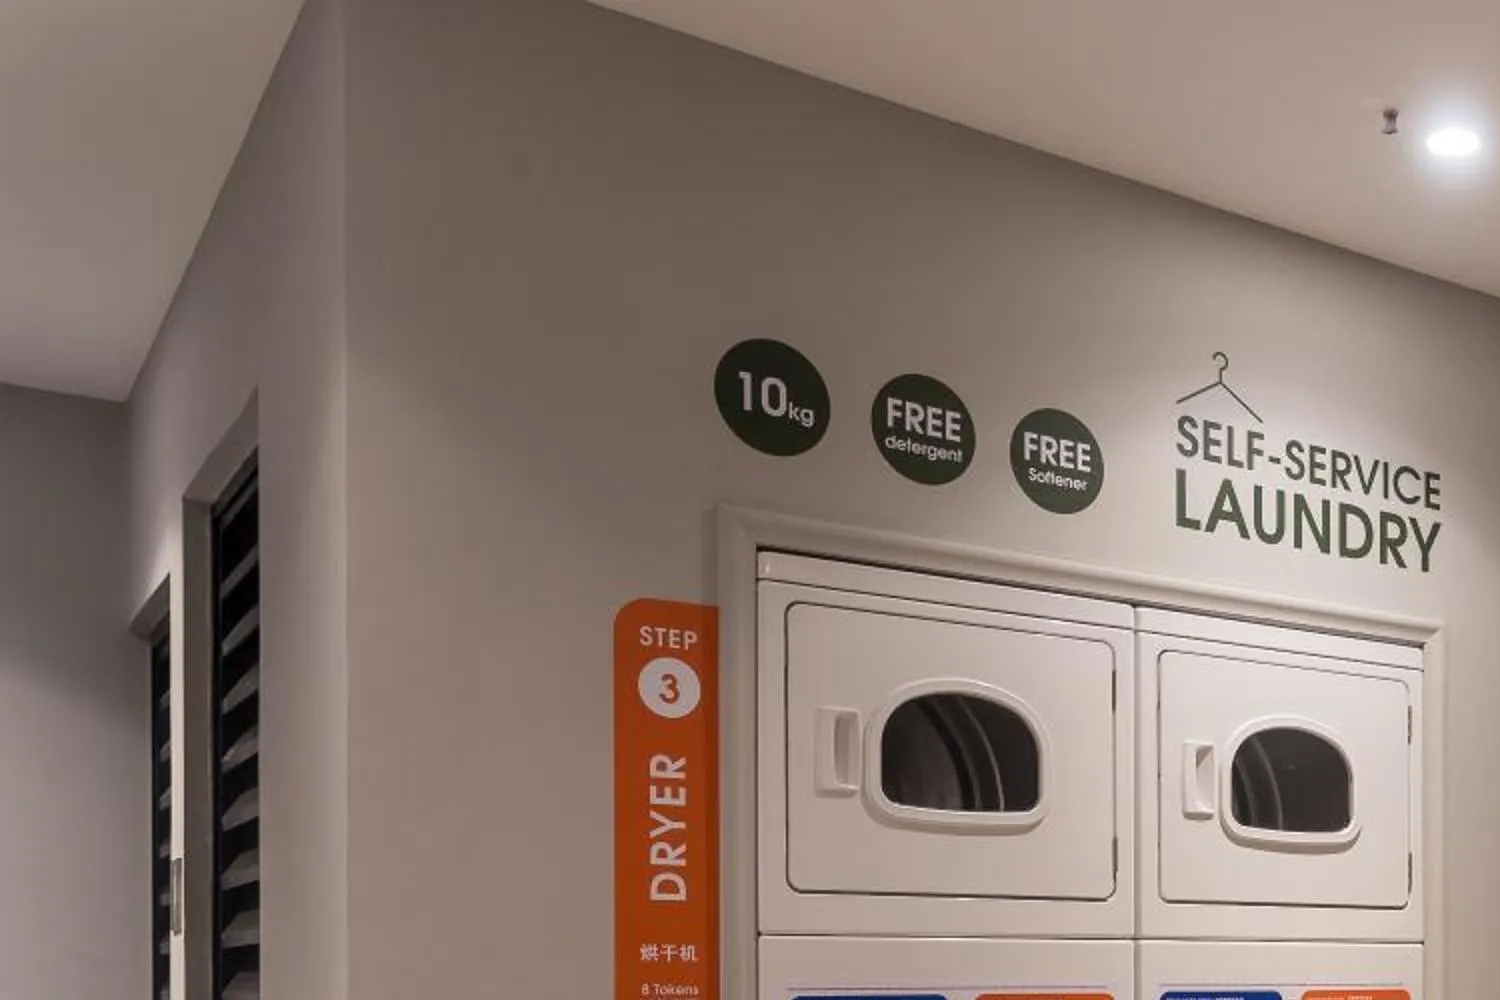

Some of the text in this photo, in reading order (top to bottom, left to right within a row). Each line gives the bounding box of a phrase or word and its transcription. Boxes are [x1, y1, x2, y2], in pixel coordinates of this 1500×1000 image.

[886, 397, 962, 443] FREE
[884, 436, 963, 464] detergent
[1023, 431, 1092, 473] FREE
[1175, 415, 1441, 511] SELF-SERVICE
[1028, 466, 1088, 492] Softener
[1175, 468, 1442, 573] LAUNDRY
[639, 625, 698, 650] STEP
[659, 673, 680, 704] 3
[650, 753, 687, 901] DRYER
[640, 943, 698, 962] 烘干机
[654, 983, 699, 997] Tokens
